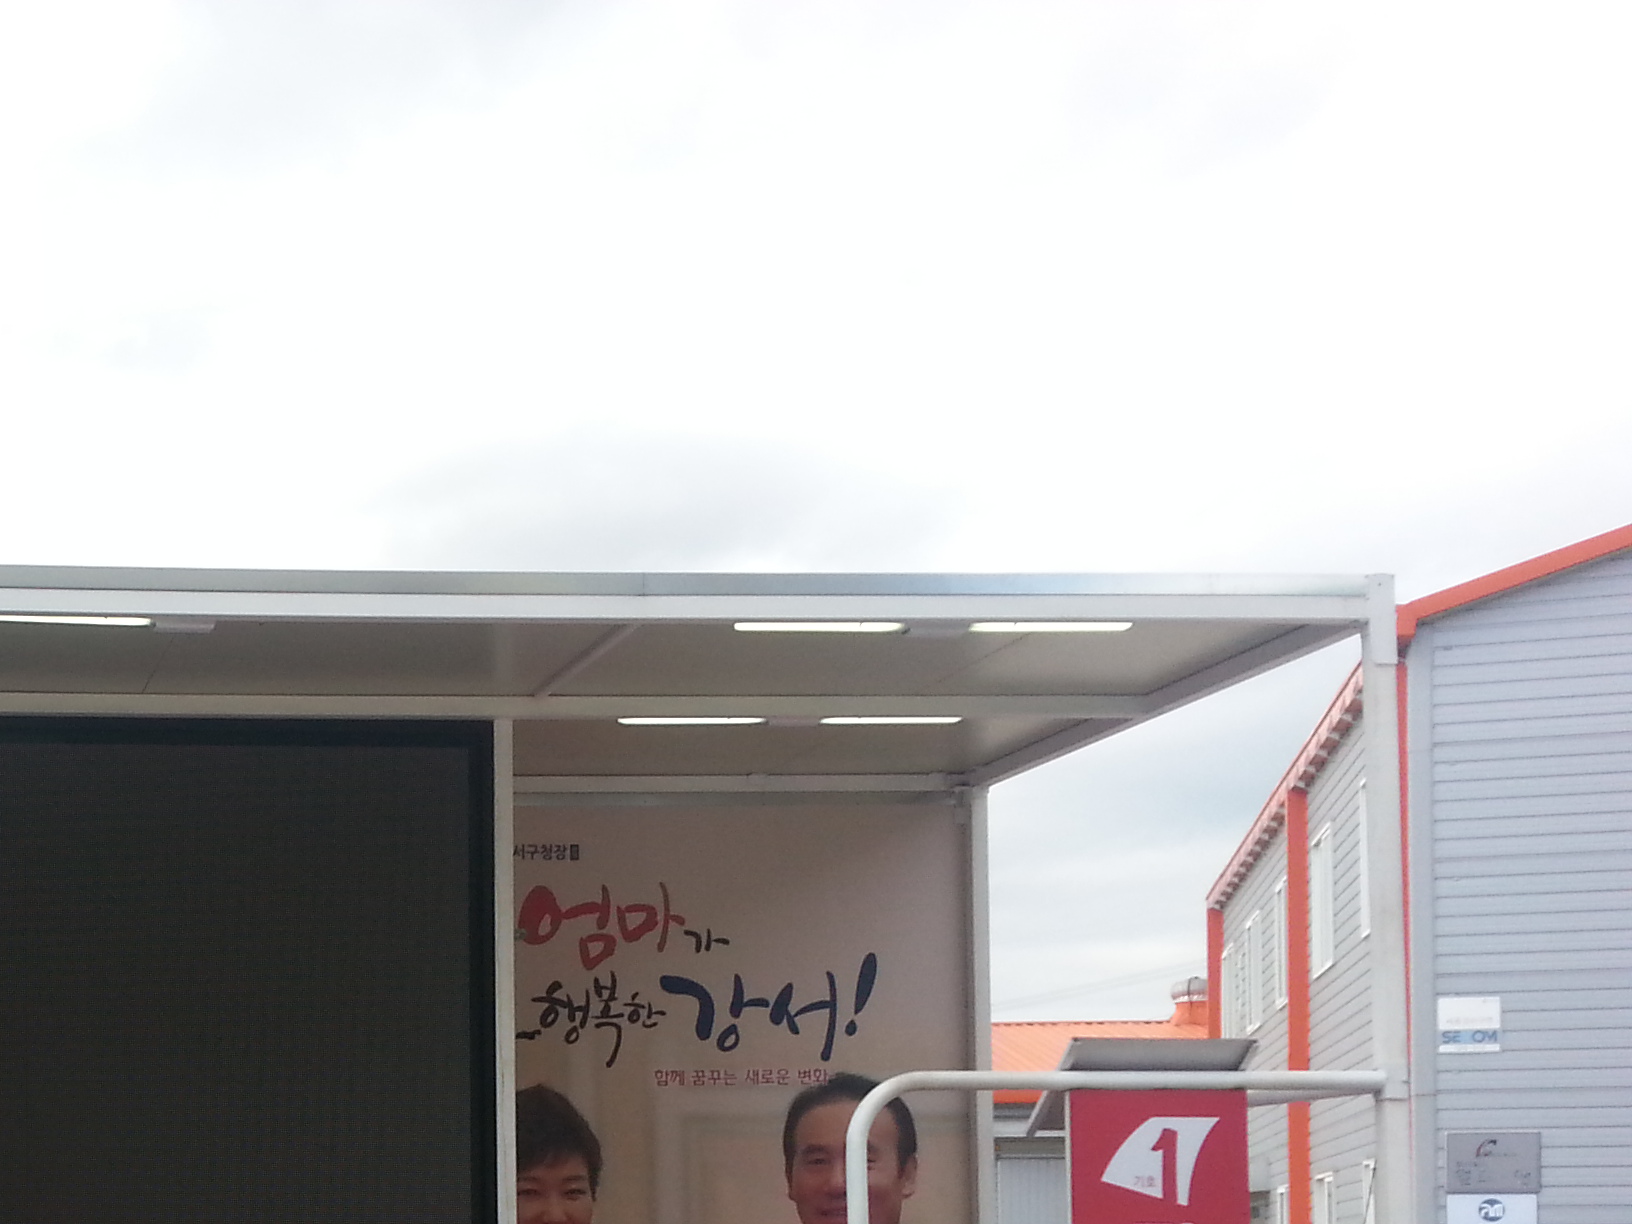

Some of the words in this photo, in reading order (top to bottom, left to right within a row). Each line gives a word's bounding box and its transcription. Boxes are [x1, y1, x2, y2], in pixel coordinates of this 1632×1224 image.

[531, 970, 666, 1068] 행복한
[660, 953, 877, 1061] 강서!
[1442, 1030, 1497, 1044] SEOM
[654, 1069, 685, 1087] 함께
[692, 1069, 737, 1086] 꿈꾸는
[745, 1069, 790, 1086] 새로운
[798, 1069, 829, 1085] 변화
